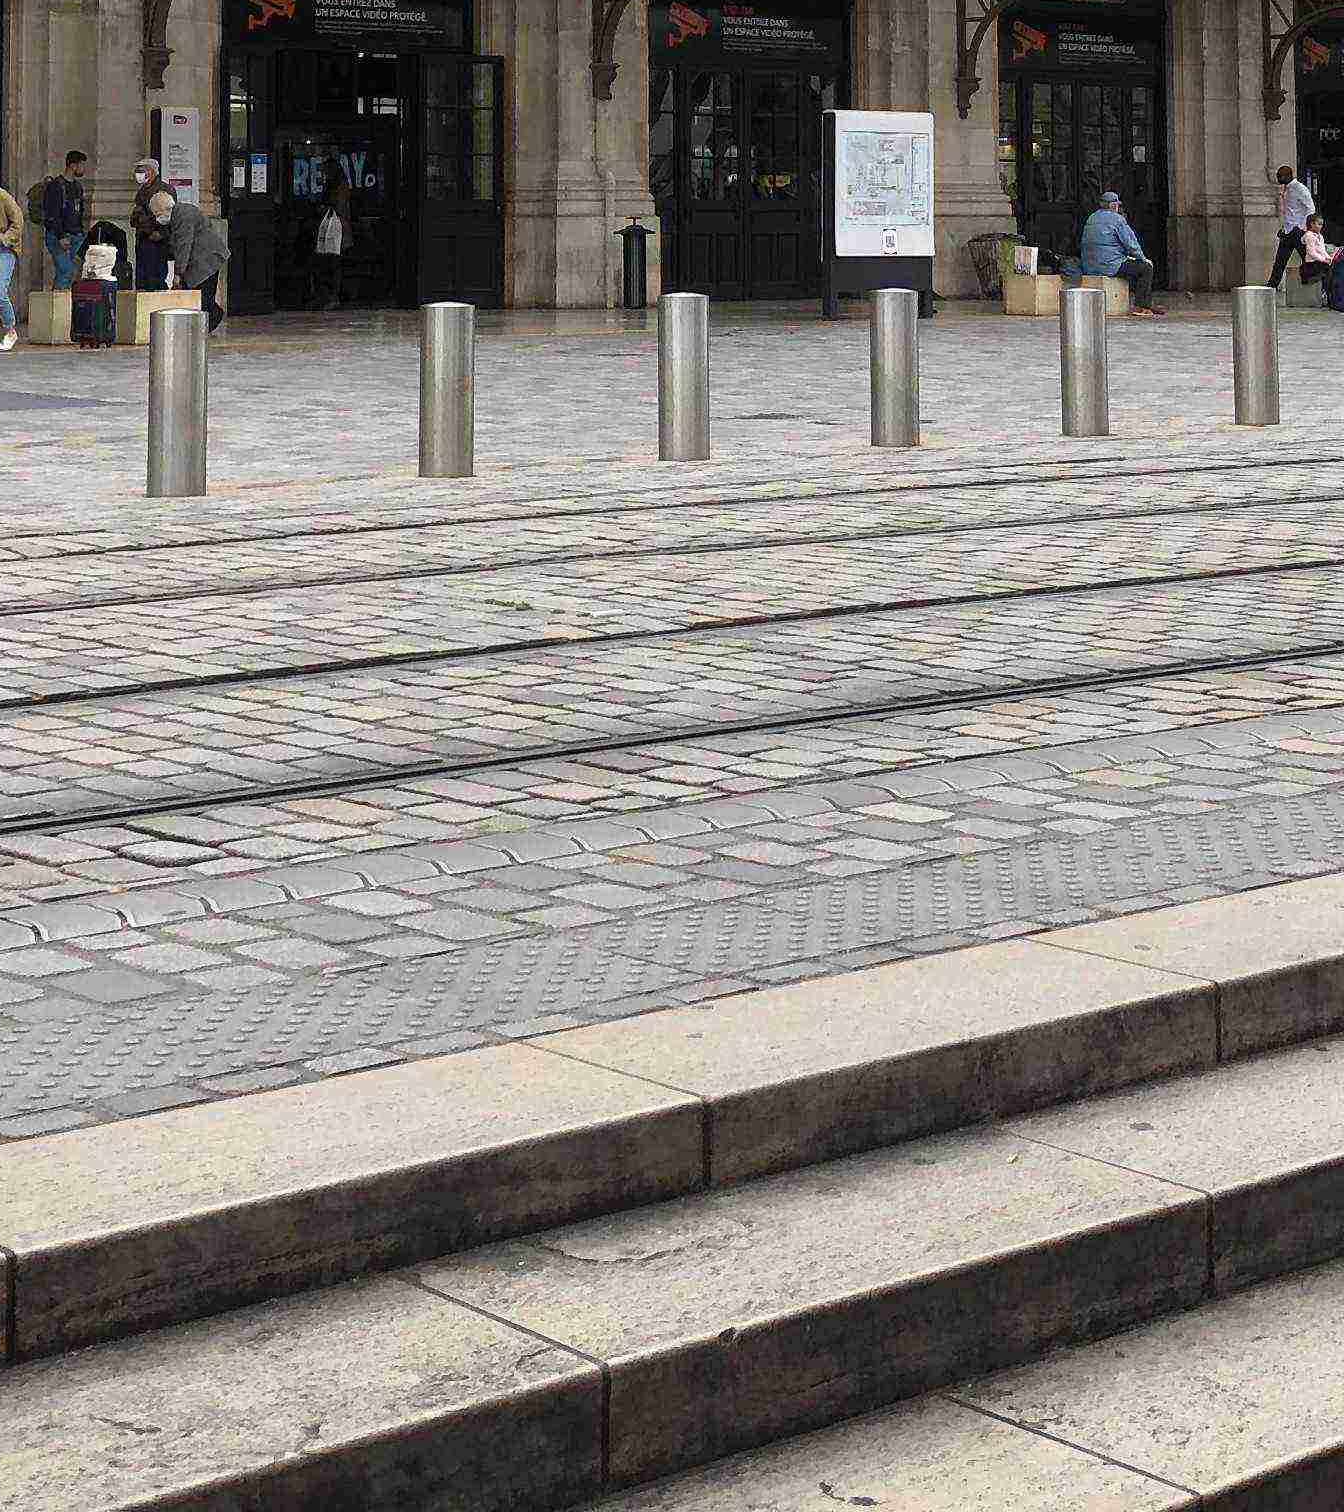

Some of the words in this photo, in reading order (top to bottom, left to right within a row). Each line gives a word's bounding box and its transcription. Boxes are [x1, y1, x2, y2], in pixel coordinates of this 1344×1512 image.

[373, 0, 397, 9] DANS
[315, 8, 329, 17] UN
[330, 9, 361, 19] ESPACE
